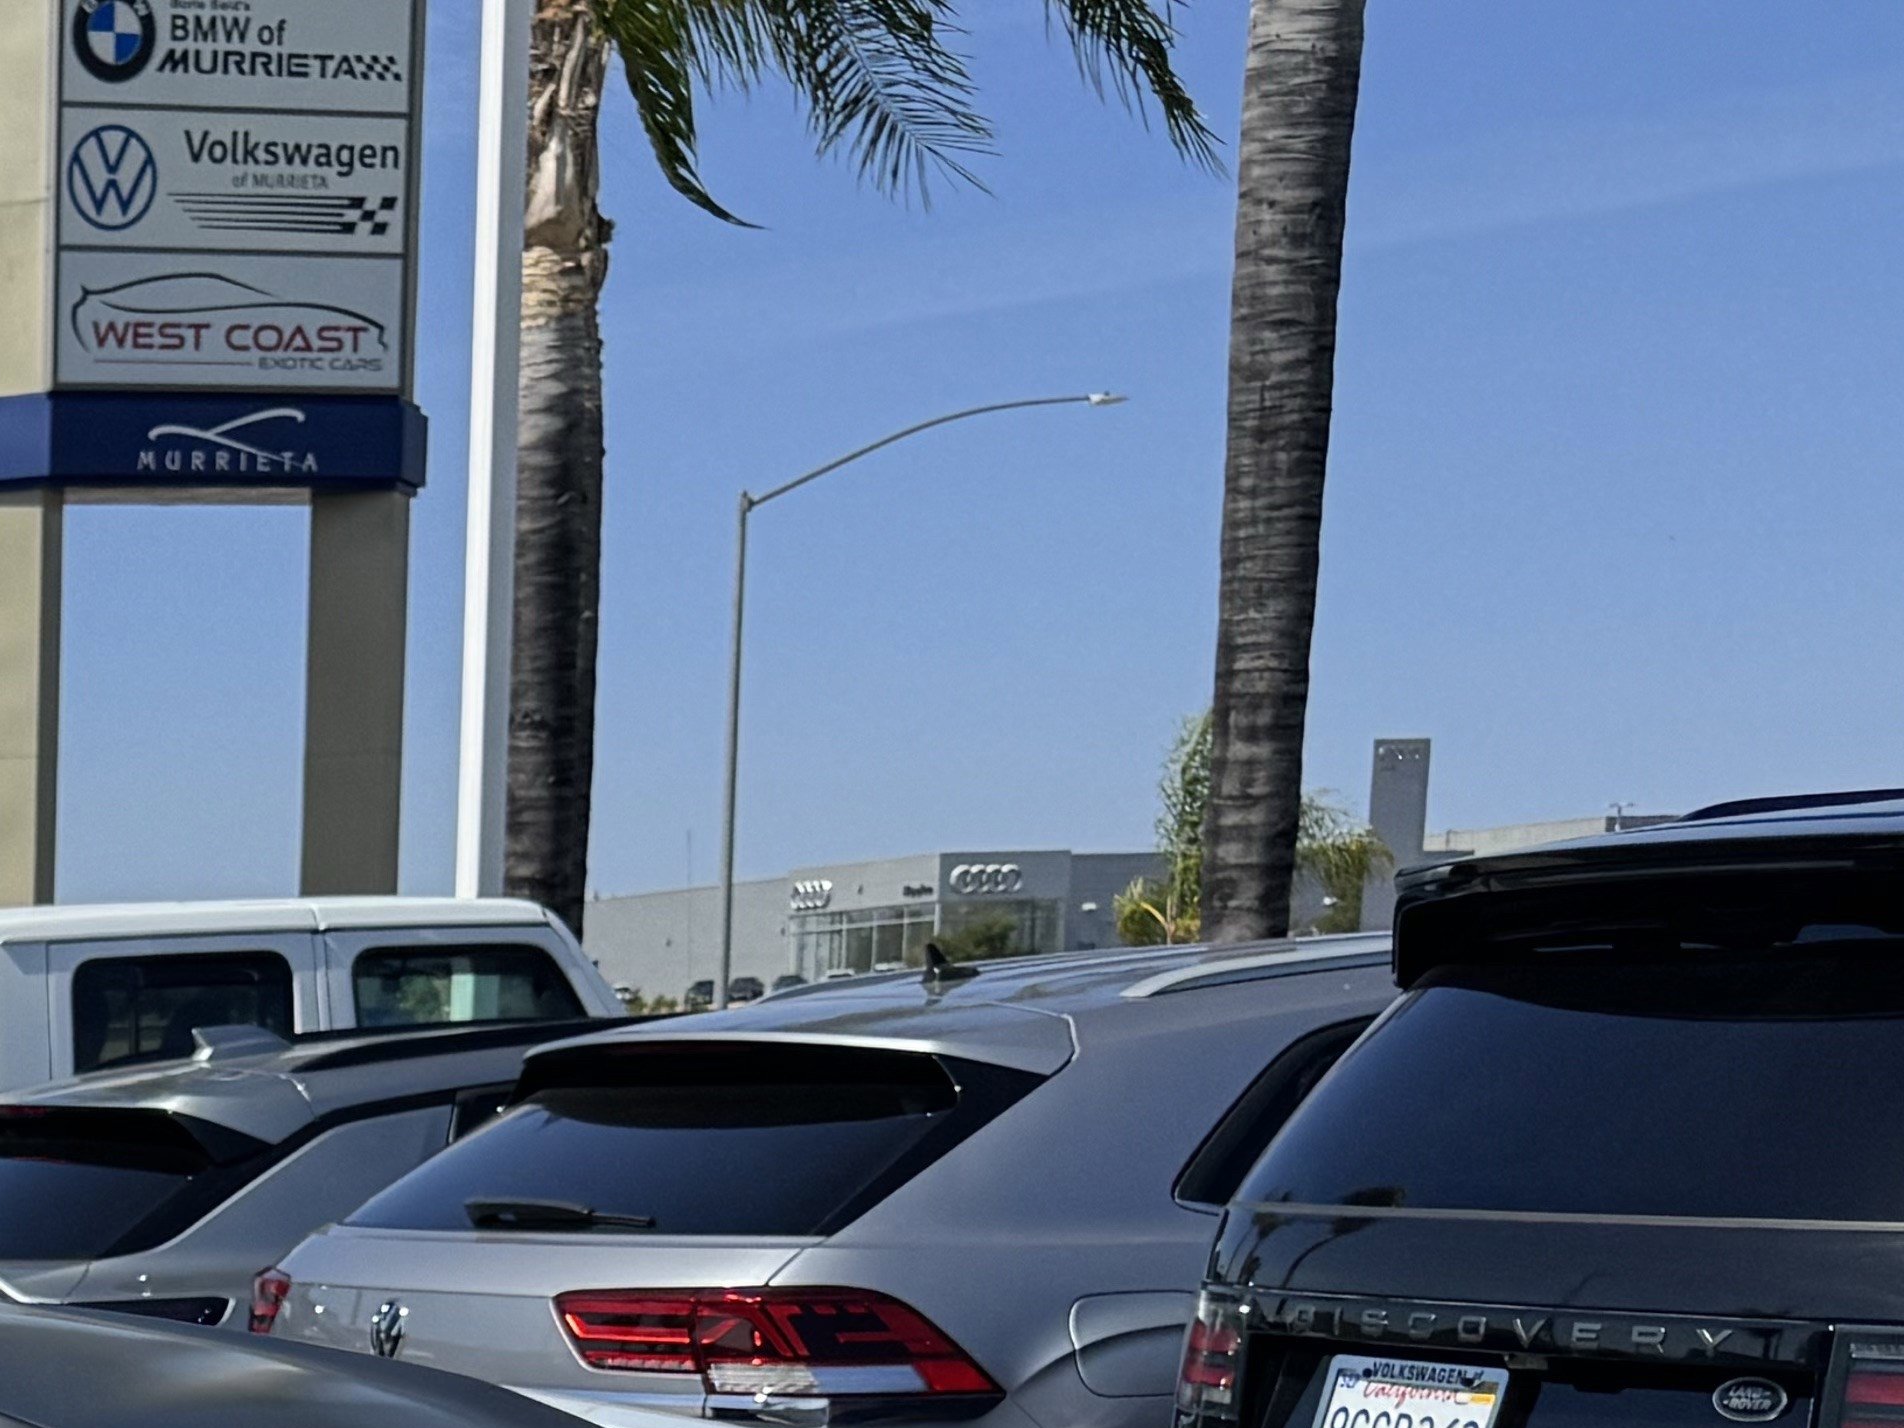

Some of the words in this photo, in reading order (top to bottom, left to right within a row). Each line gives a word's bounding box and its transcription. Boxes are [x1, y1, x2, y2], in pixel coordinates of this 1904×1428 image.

[169, 14, 251, 44] BMW
[257, 19, 287, 46] of
[156, 49, 358, 80] MURRIETA
[184, 130, 400, 176] Volkswagen
[233, 172, 248, 188] of
[252, 173, 329, 190] MURRIETA
[92, 321, 210, 352] WEST
[225, 324, 370, 354] COAST
[258, 357, 324, 371] EXOTIC
[329, 358, 383, 372] CARS
[137, 449, 318, 473] MURRIETA
[1293, 1304, 1734, 1358] DISCOVERY
[1372, 1361, 1468, 1386] VOLKSWAGEN
